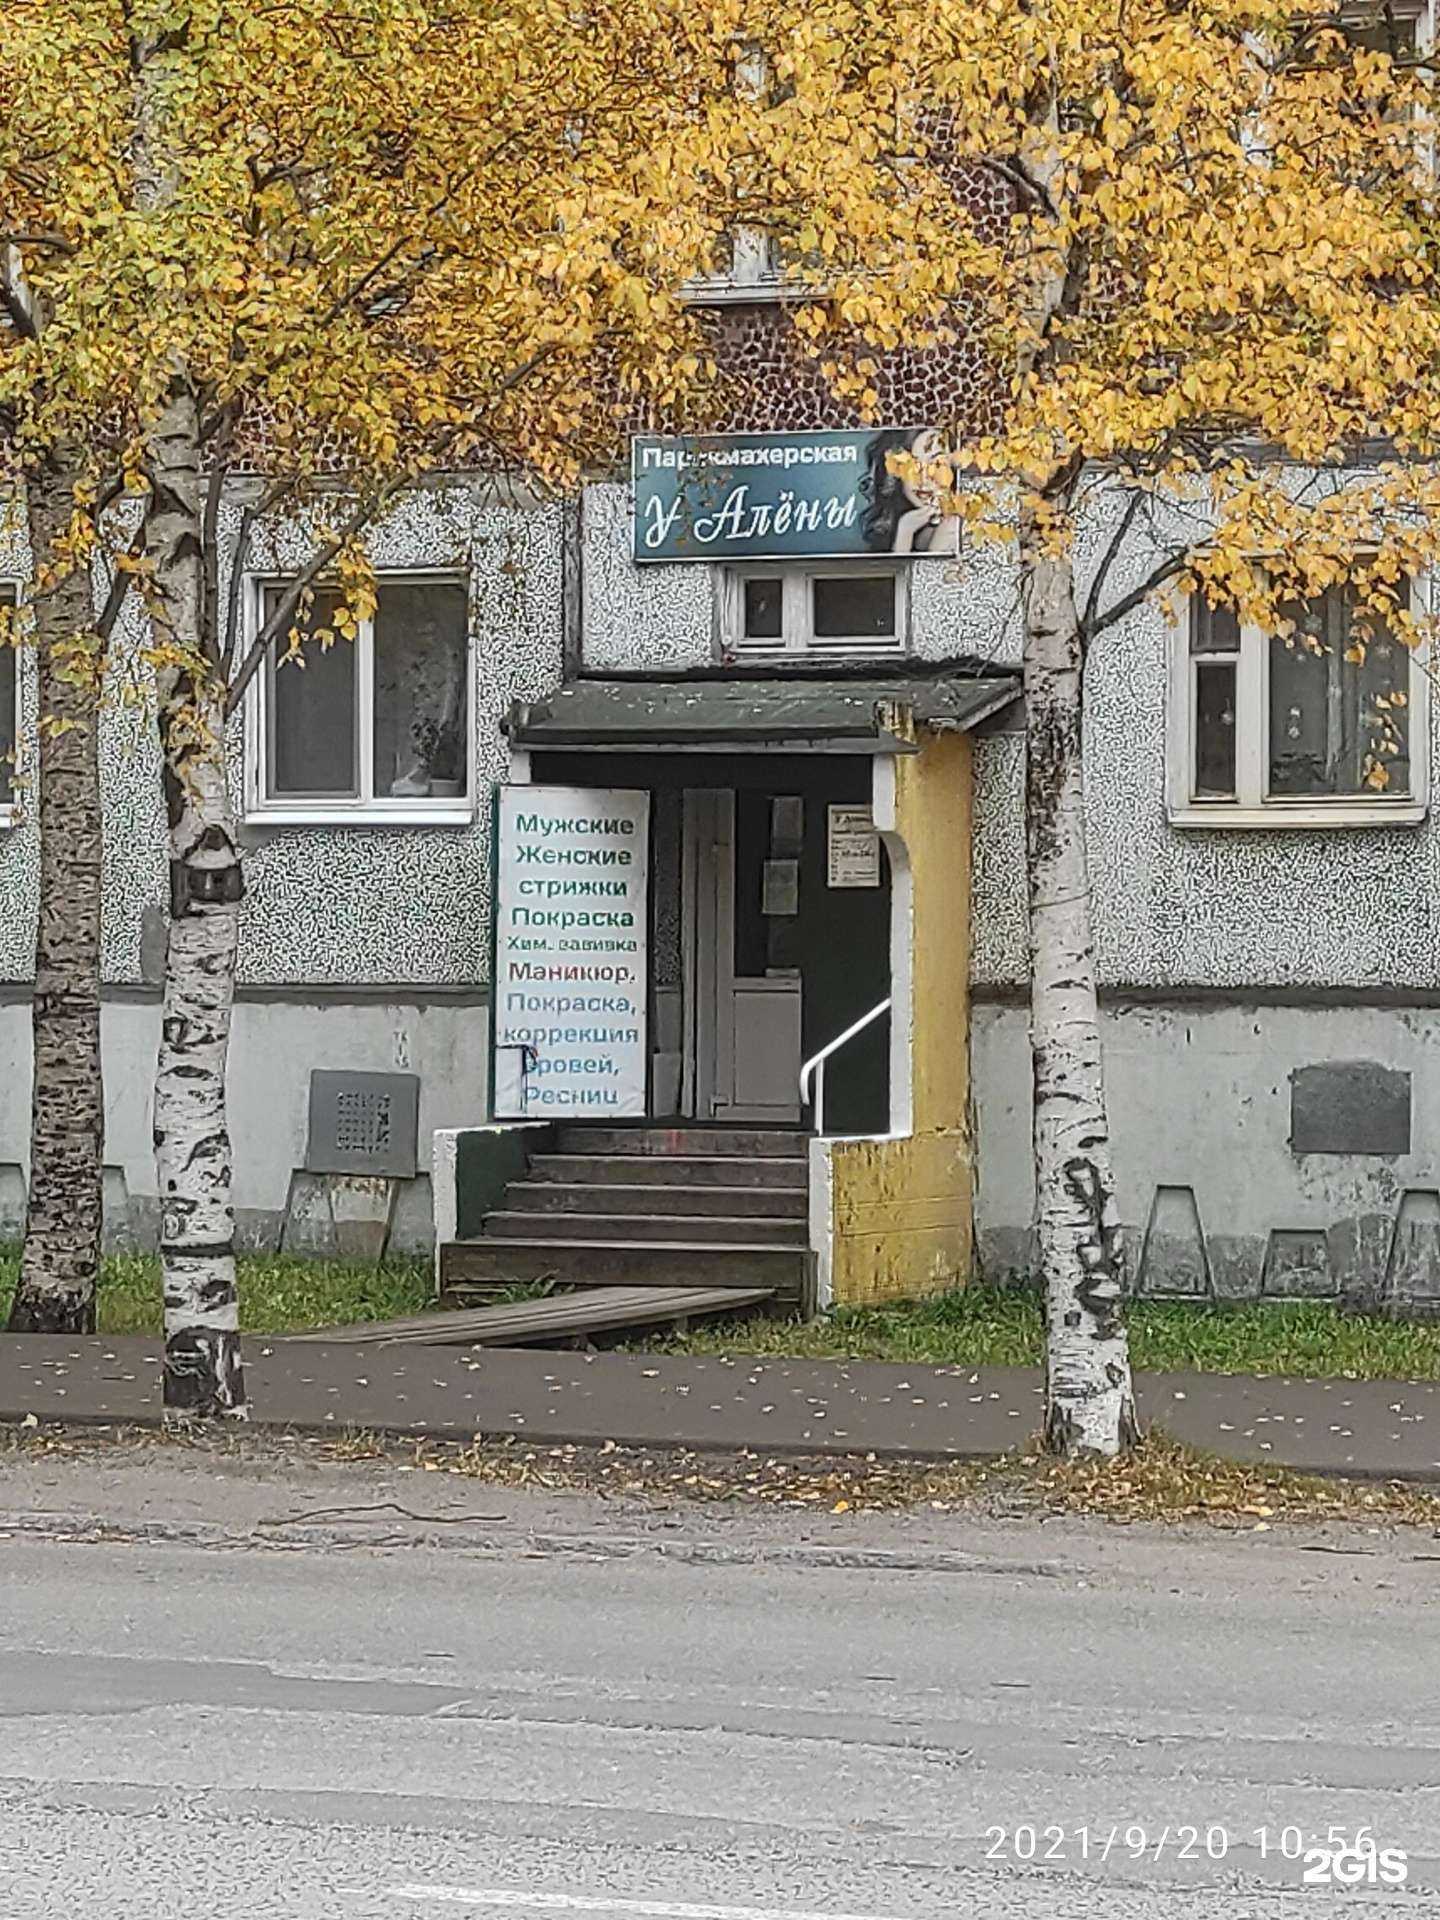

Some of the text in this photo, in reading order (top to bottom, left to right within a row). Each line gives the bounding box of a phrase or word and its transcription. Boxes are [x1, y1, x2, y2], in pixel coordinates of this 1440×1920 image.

[693, 484, 857, 542] Алёны
[515, 814, 634, 836] Мужские
[515, 845, 632, 865] Женские
[519, 879, 627, 897] стрижки
[512, 907, 634, 929] Покраска
[507, 935, 637, 952] Хим. завивка
[509, 962, 636, 984] Маникюр,
[507, 993, 636, 1016] Покраска,
[505, 1027, 638, 1045] коррекция
